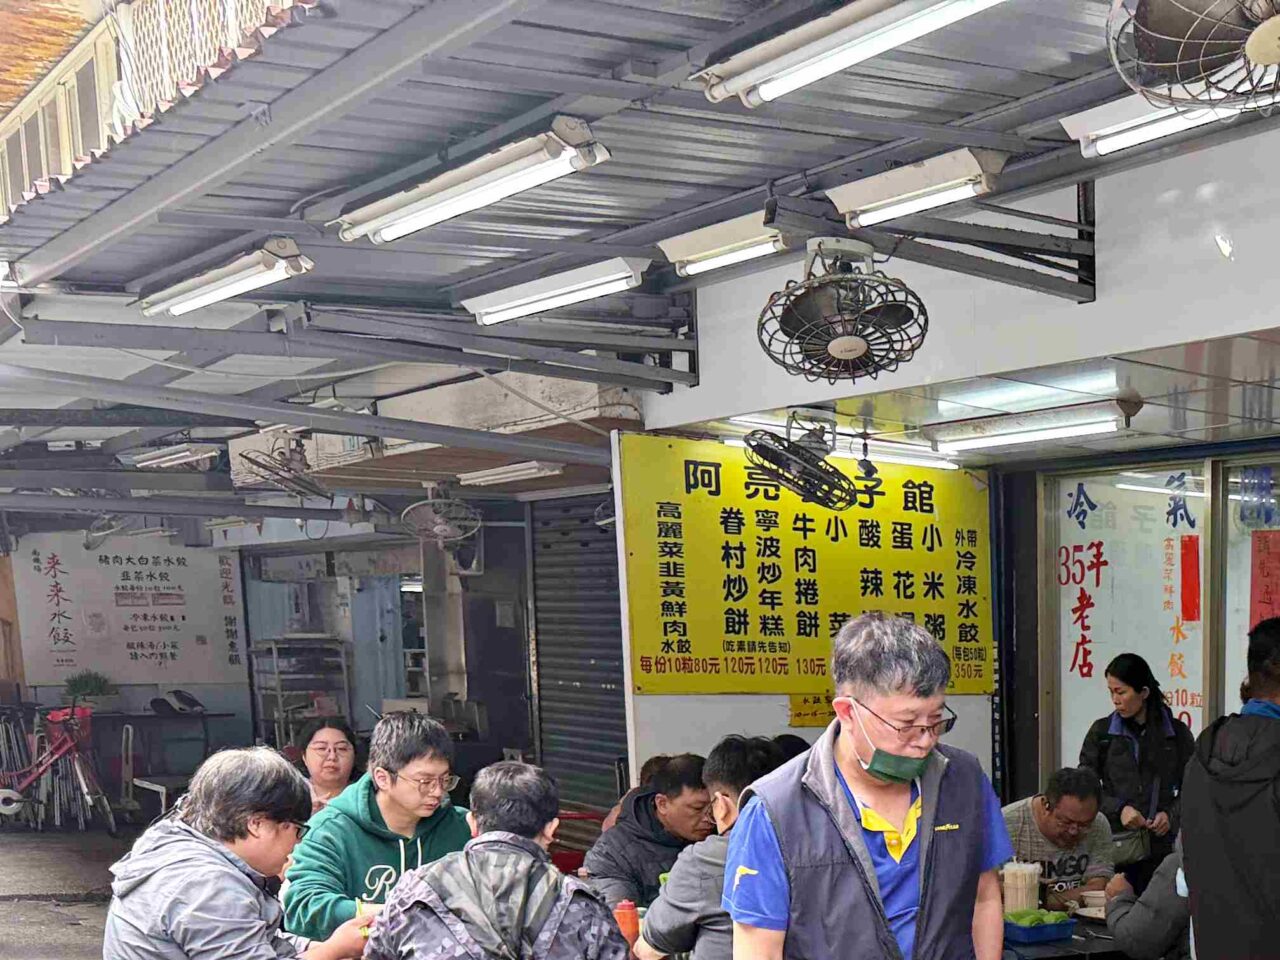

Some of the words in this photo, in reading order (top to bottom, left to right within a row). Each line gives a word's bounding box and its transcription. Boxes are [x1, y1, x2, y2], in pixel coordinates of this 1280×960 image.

[683, 459, 935, 515] 阿亮子館
[719, 506, 750, 636] 眷村炒餅
[754, 509, 786, 637] 寧波炒年糕
[792, 513, 820, 638] 牛肉捲餅
[724, 656, 756, 675] 120元
[758, 657, 789, 675] 120元
[796, 658, 827, 676] 130元
[954, 664, 983, 679] 350元
